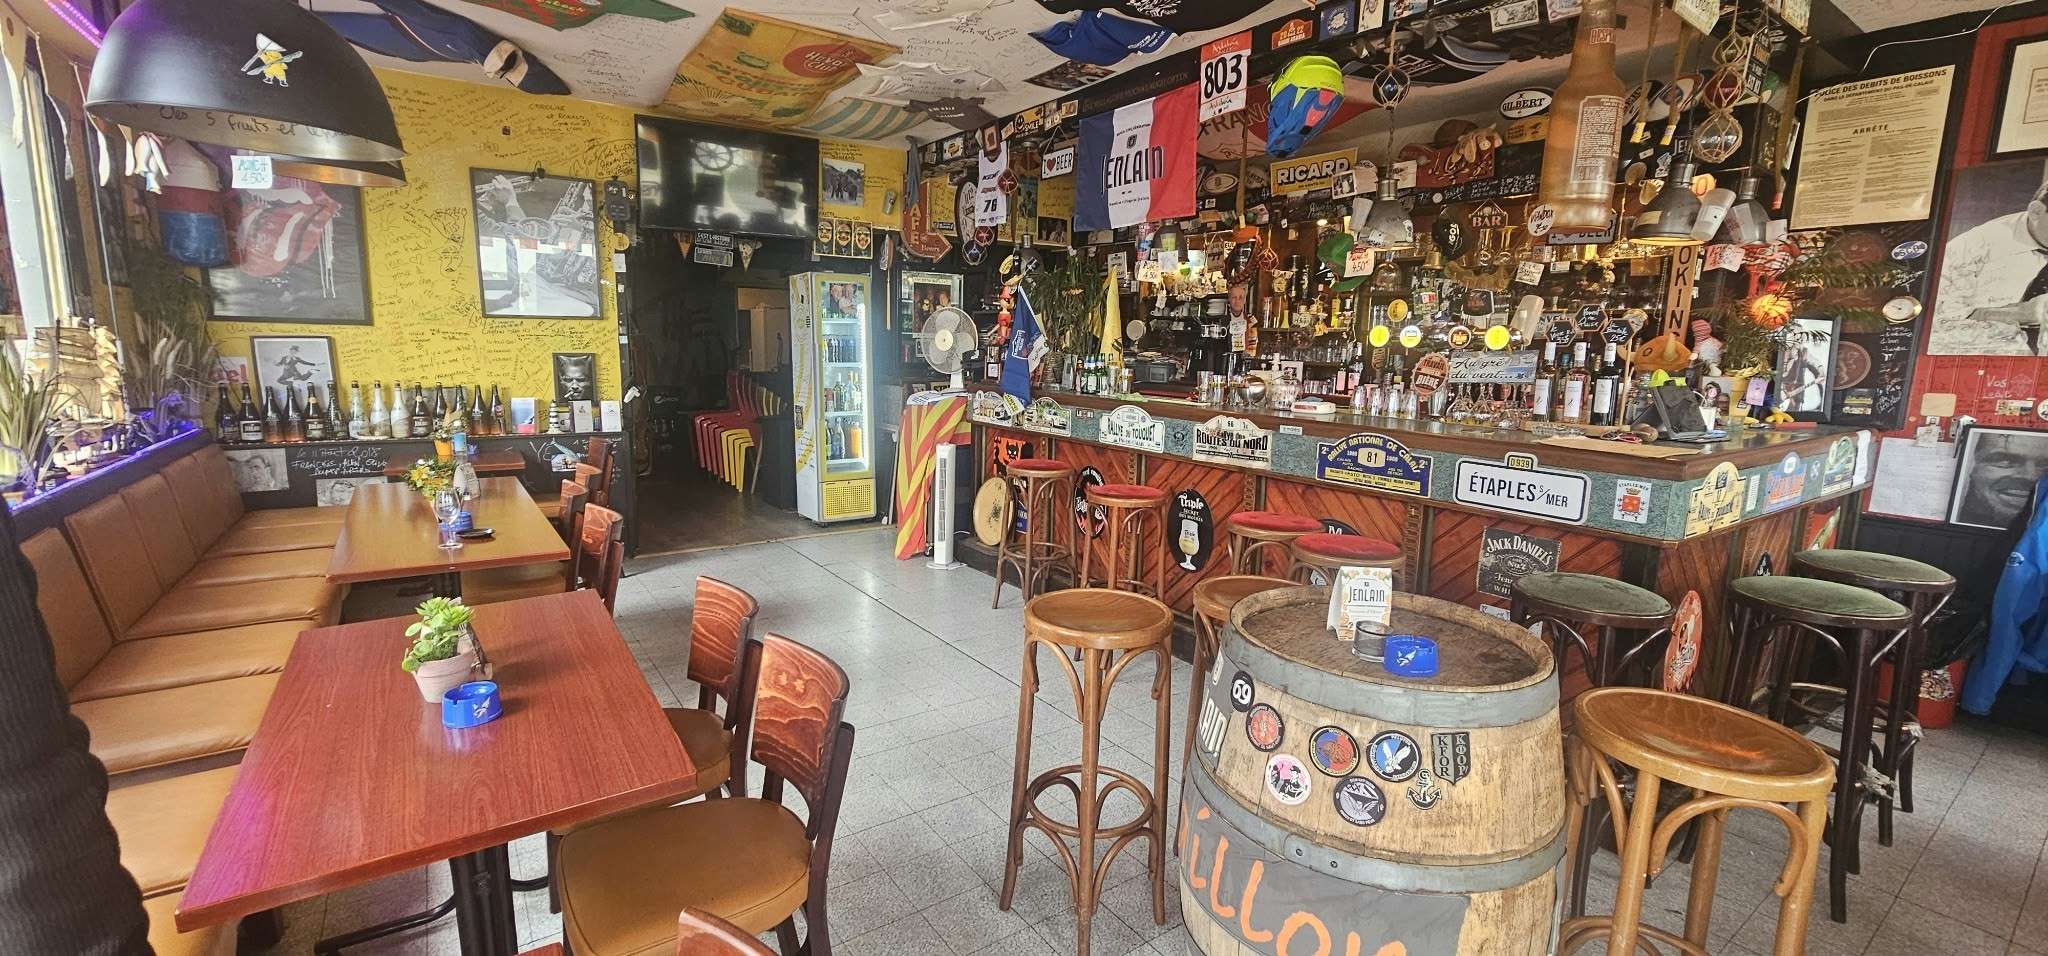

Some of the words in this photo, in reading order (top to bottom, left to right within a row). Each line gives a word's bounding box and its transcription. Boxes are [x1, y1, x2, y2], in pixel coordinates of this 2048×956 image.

[1204, 54, 1243, 99] 803
[1843, 84, 1857, 92] DES
[1903, 69, 1947, 82] BOISSONS
[1503, 98, 1545, 111] GILBERT
[205, 112, 216, 126] 5
[1056, 153, 1073, 171] BEER
[1101, 146, 1165, 196] JENLAIN
[1278, 158, 1350, 184] RICARD
[1472, 216, 1501, 228] BAR
[1451, 370, 1468, 379] du
[1453, 357, 1478, 369] Au
[1481, 357, 1504, 371] gré
[1107, 417, 1123, 437] RALLYE
[1132, 424, 1155, 442] TOUQUET
[1197, 428, 1227, 446] ROUTES
[1230, 440, 1240, 448] DU
[1244, 435, 1269, 451] NORD
[1327, 441, 1348, 461] RALLYE
[1349, 436, 1384, 446] NATIONAL
[1386, 441, 1398, 452] DE
[1367, 452, 1378, 464] 81
[1510, 458, 1530, 469] D939
[1469, 471, 1537, 502] ÉTAPLES
[1178, 493, 1204, 509] Triple
[1487, 538, 1512, 552] JACK
[1513, 535, 1554, 566] DANIEL'S
[1348, 586, 1385, 603] JENLAIN
[1232, 679, 1252, 705] 69
[1438, 735, 1450, 777] KFOR
